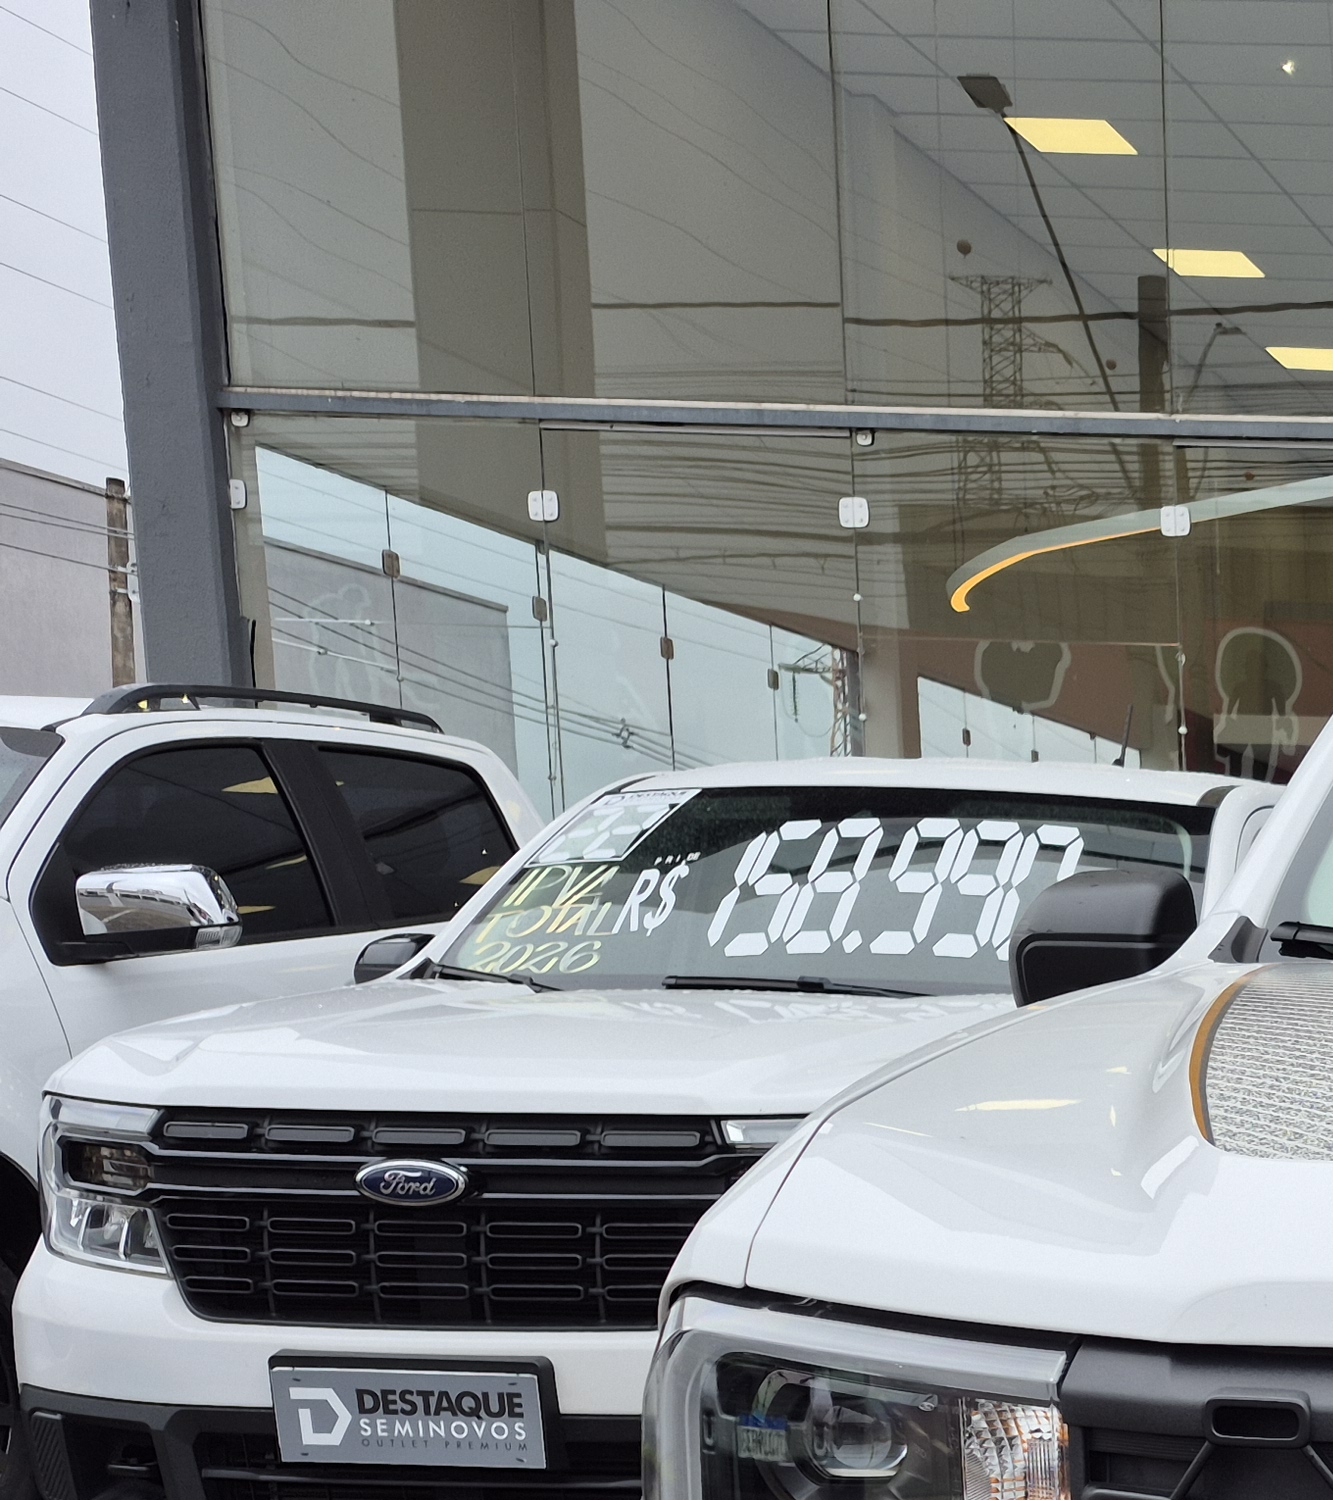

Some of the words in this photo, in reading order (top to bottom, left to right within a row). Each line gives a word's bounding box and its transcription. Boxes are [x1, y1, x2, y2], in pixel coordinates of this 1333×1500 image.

[501, 864, 621, 909] IPVA
[611, 860, 690, 937] R$
[474, 901, 614, 944] TOTAL
[466, 940, 602, 974] 2026
[379, 1169, 437, 1196] Ford
[355, 1387, 525, 1421] DESTAQUE
[359, 1417, 528, 1441] SEMINOVOS
[361, 1438, 429, 1449] OUTLET
[444, 1440, 528, 1452] PREMIUM
